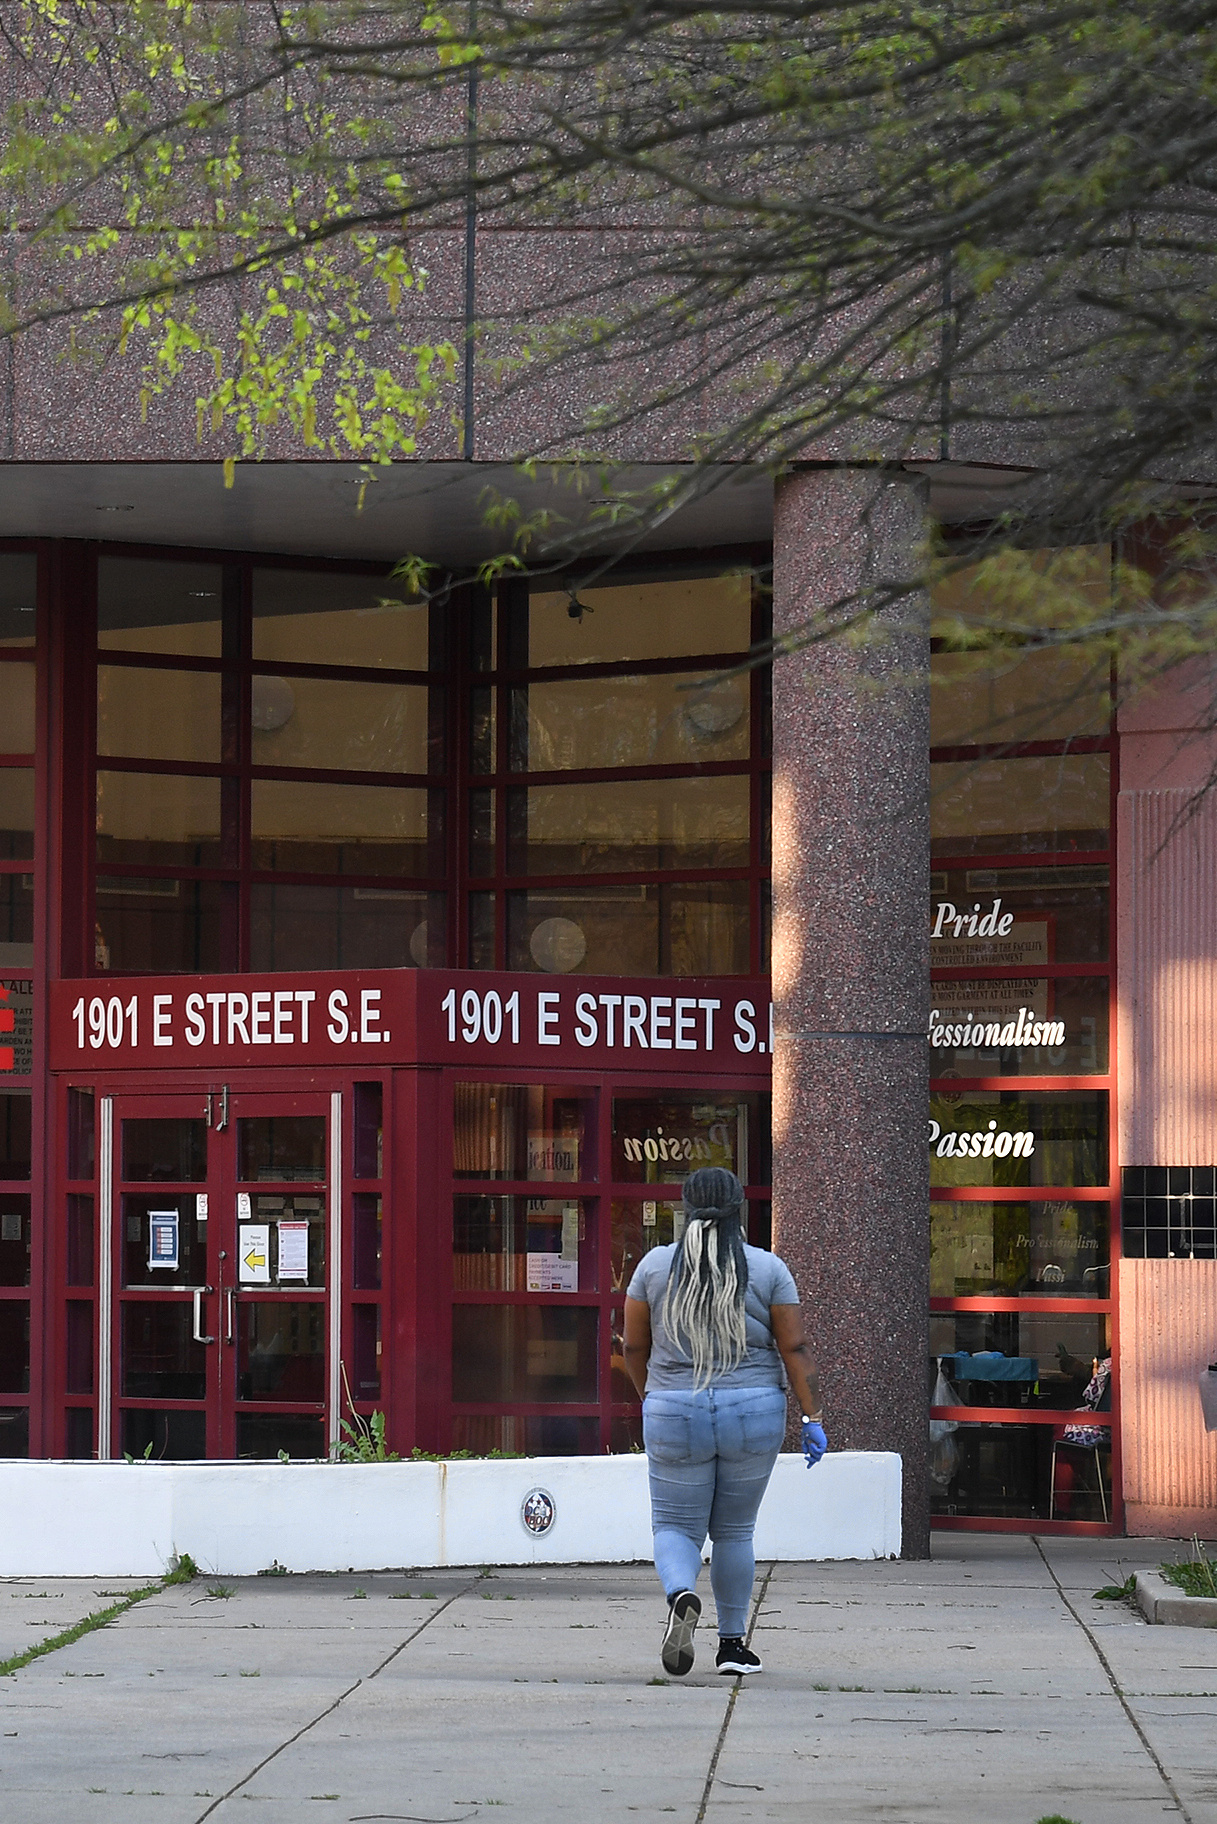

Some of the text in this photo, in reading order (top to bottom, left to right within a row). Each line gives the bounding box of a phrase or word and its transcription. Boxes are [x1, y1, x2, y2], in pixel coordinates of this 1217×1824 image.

[930, 898, 1014, 938] Pride
[72, 989, 391, 1049] 1901 E STREET S.E.
[441, 988, 774, 1053] 1901 E STREET S.
[1016, 1234, 1100, 1250] Proessionalism
